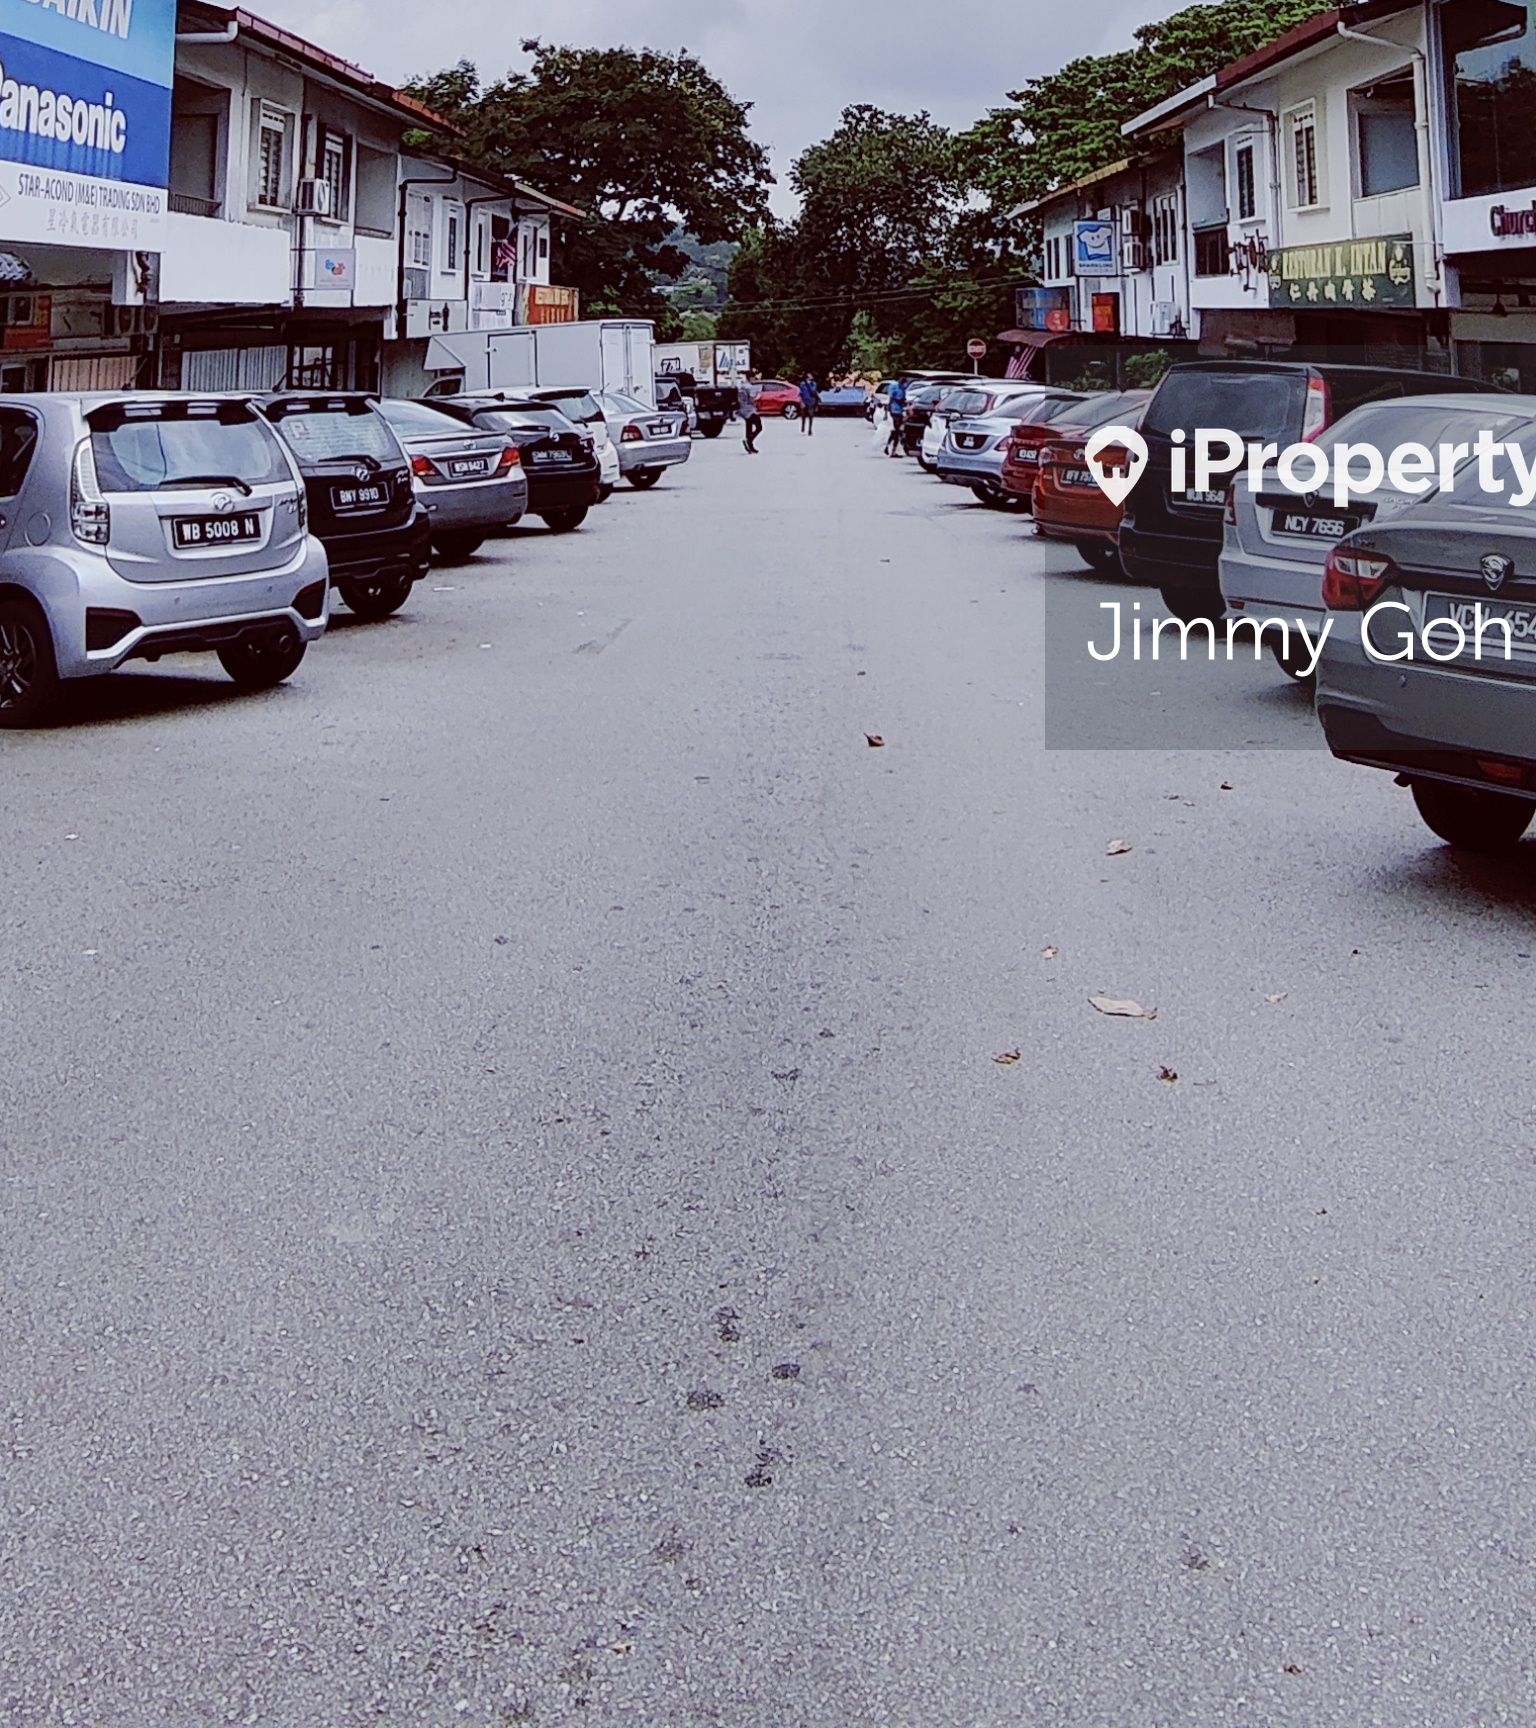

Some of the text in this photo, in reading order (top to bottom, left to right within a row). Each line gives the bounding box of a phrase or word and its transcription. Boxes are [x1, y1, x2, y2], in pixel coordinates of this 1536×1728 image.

[18, 173, 74, 202] STAR-ACOND
[99, 186, 130, 211] TRADING
[131, 191, 146, 214] SDN
[146, 194, 160, 215] BHD
[182, 518, 254, 542] WB 5008 N
[1284, 514, 1346, 536] NCY 7656
